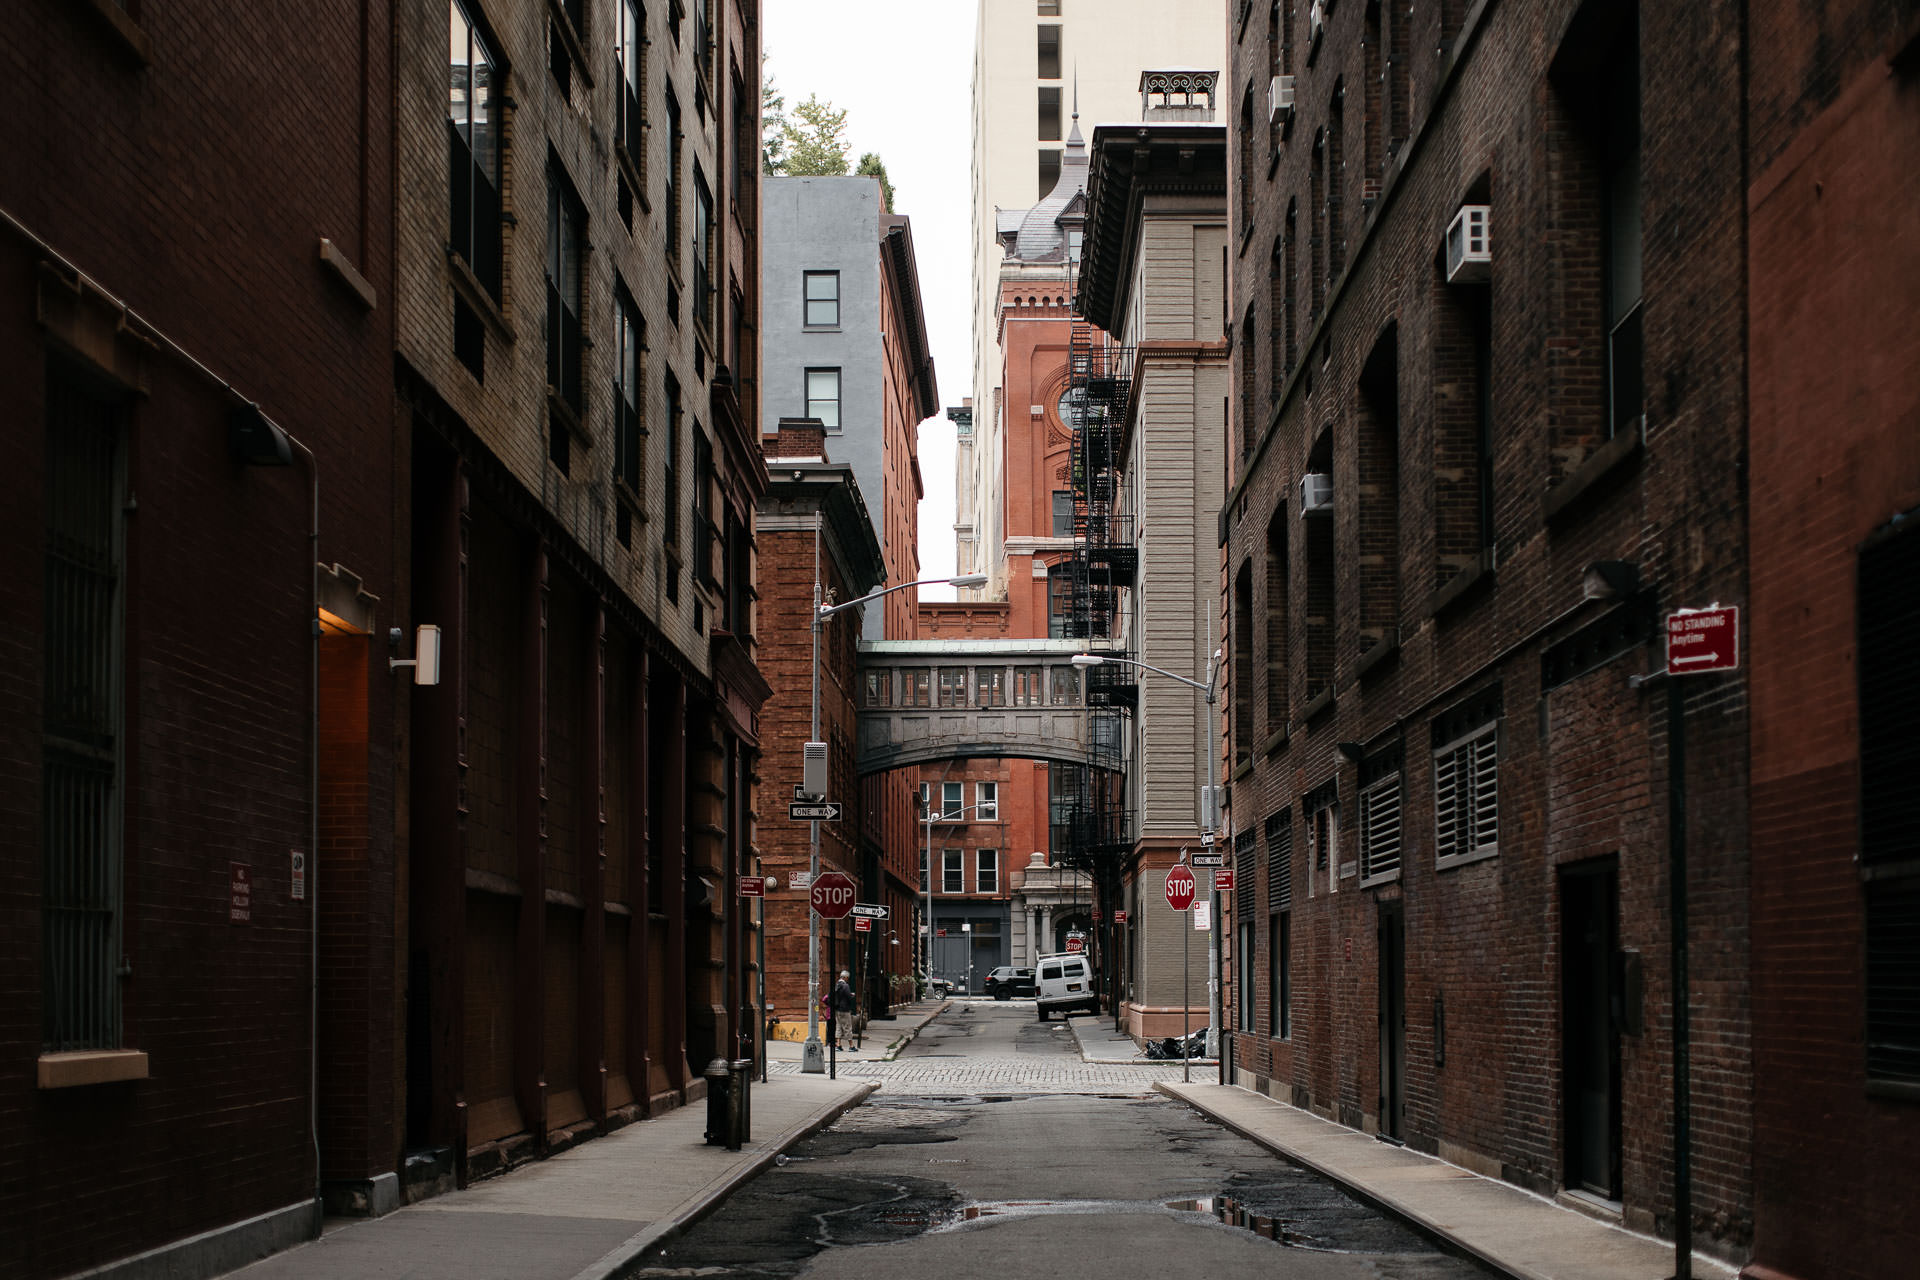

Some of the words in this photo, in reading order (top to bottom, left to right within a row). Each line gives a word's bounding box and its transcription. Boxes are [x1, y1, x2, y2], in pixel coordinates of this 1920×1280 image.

[1671, 621, 1683, 632] NO
[1685, 615, 1725, 631] STANDING
[1671, 633, 1705, 646] Anytime
[796, 808, 812, 816] ONE
[817, 808, 834, 816] WAY
[1167, 879, 1194, 897] STOP
[813, 887, 853, 905] STOP
[871, 908, 885, 916] WAY
